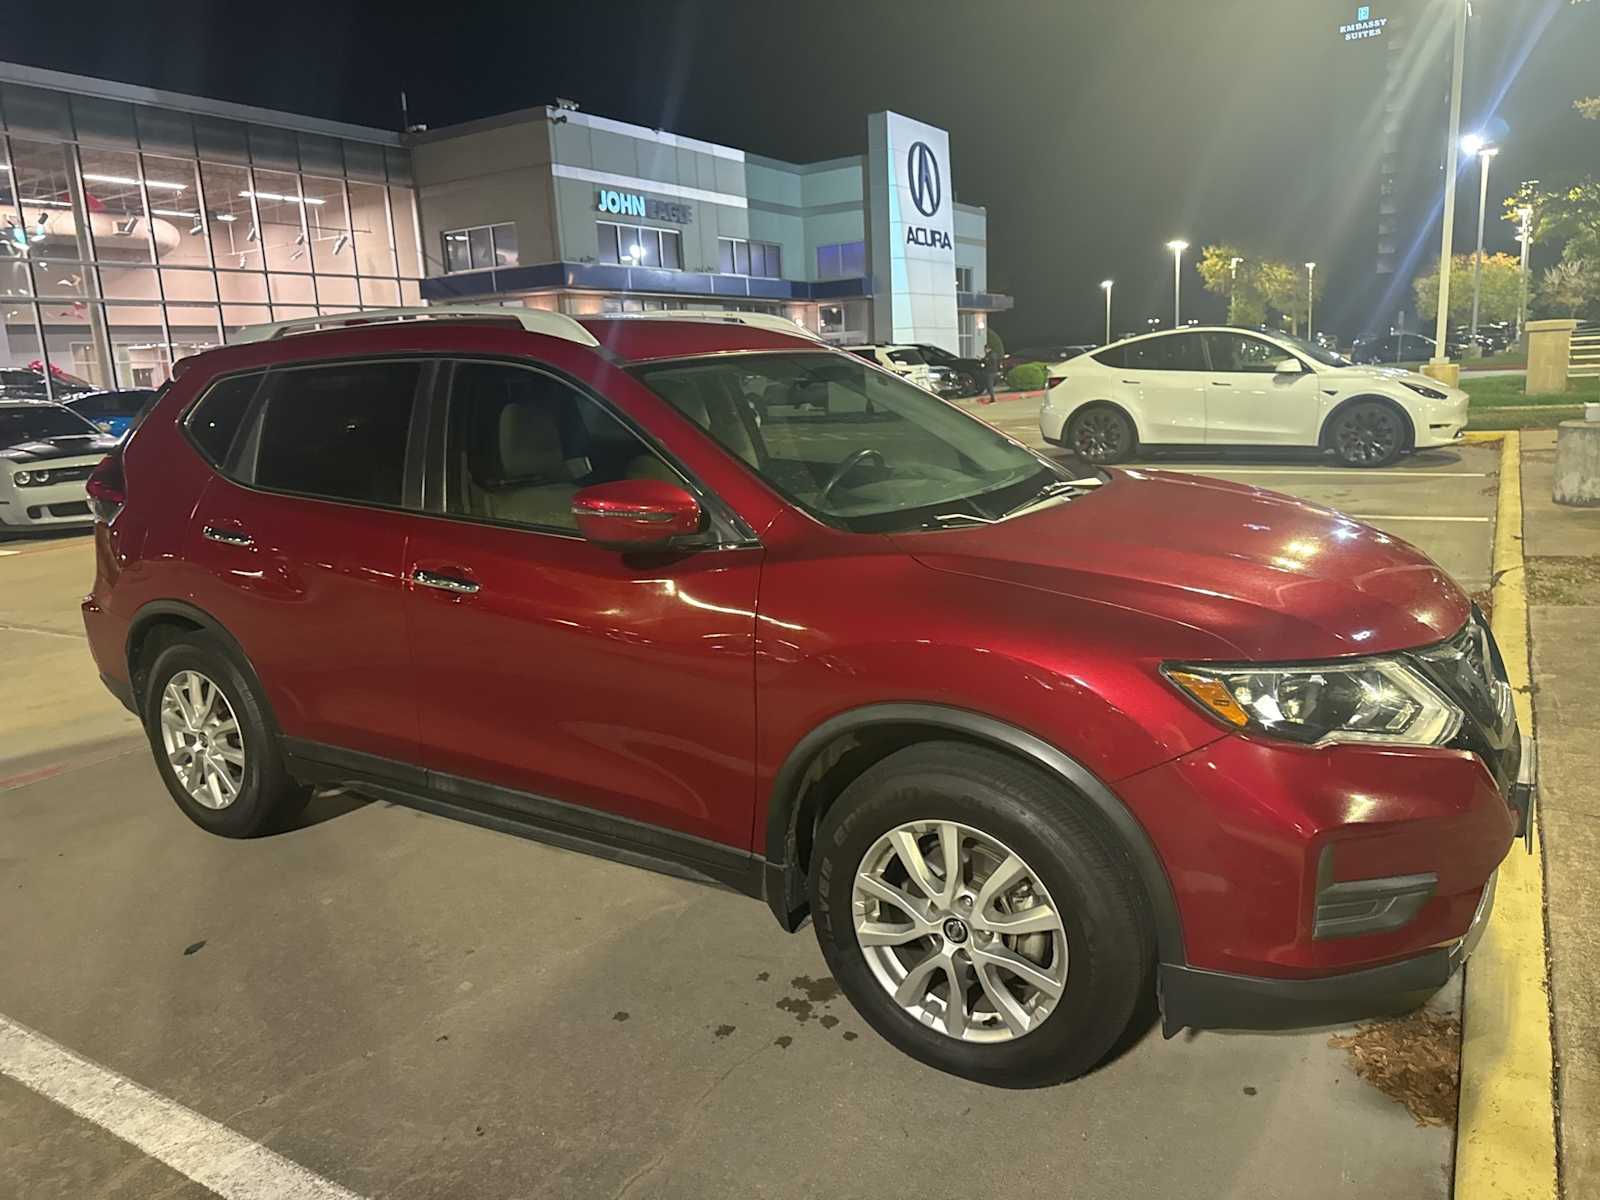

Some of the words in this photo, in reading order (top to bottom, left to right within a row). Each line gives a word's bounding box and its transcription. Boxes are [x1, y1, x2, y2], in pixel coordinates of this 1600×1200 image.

[1340, 18, 1387, 33] EMBASSY
[1345, 28, 1381, 40] SUITES
[598, 190, 646, 217] JOHN
[906, 226, 952, 250] ACURA
